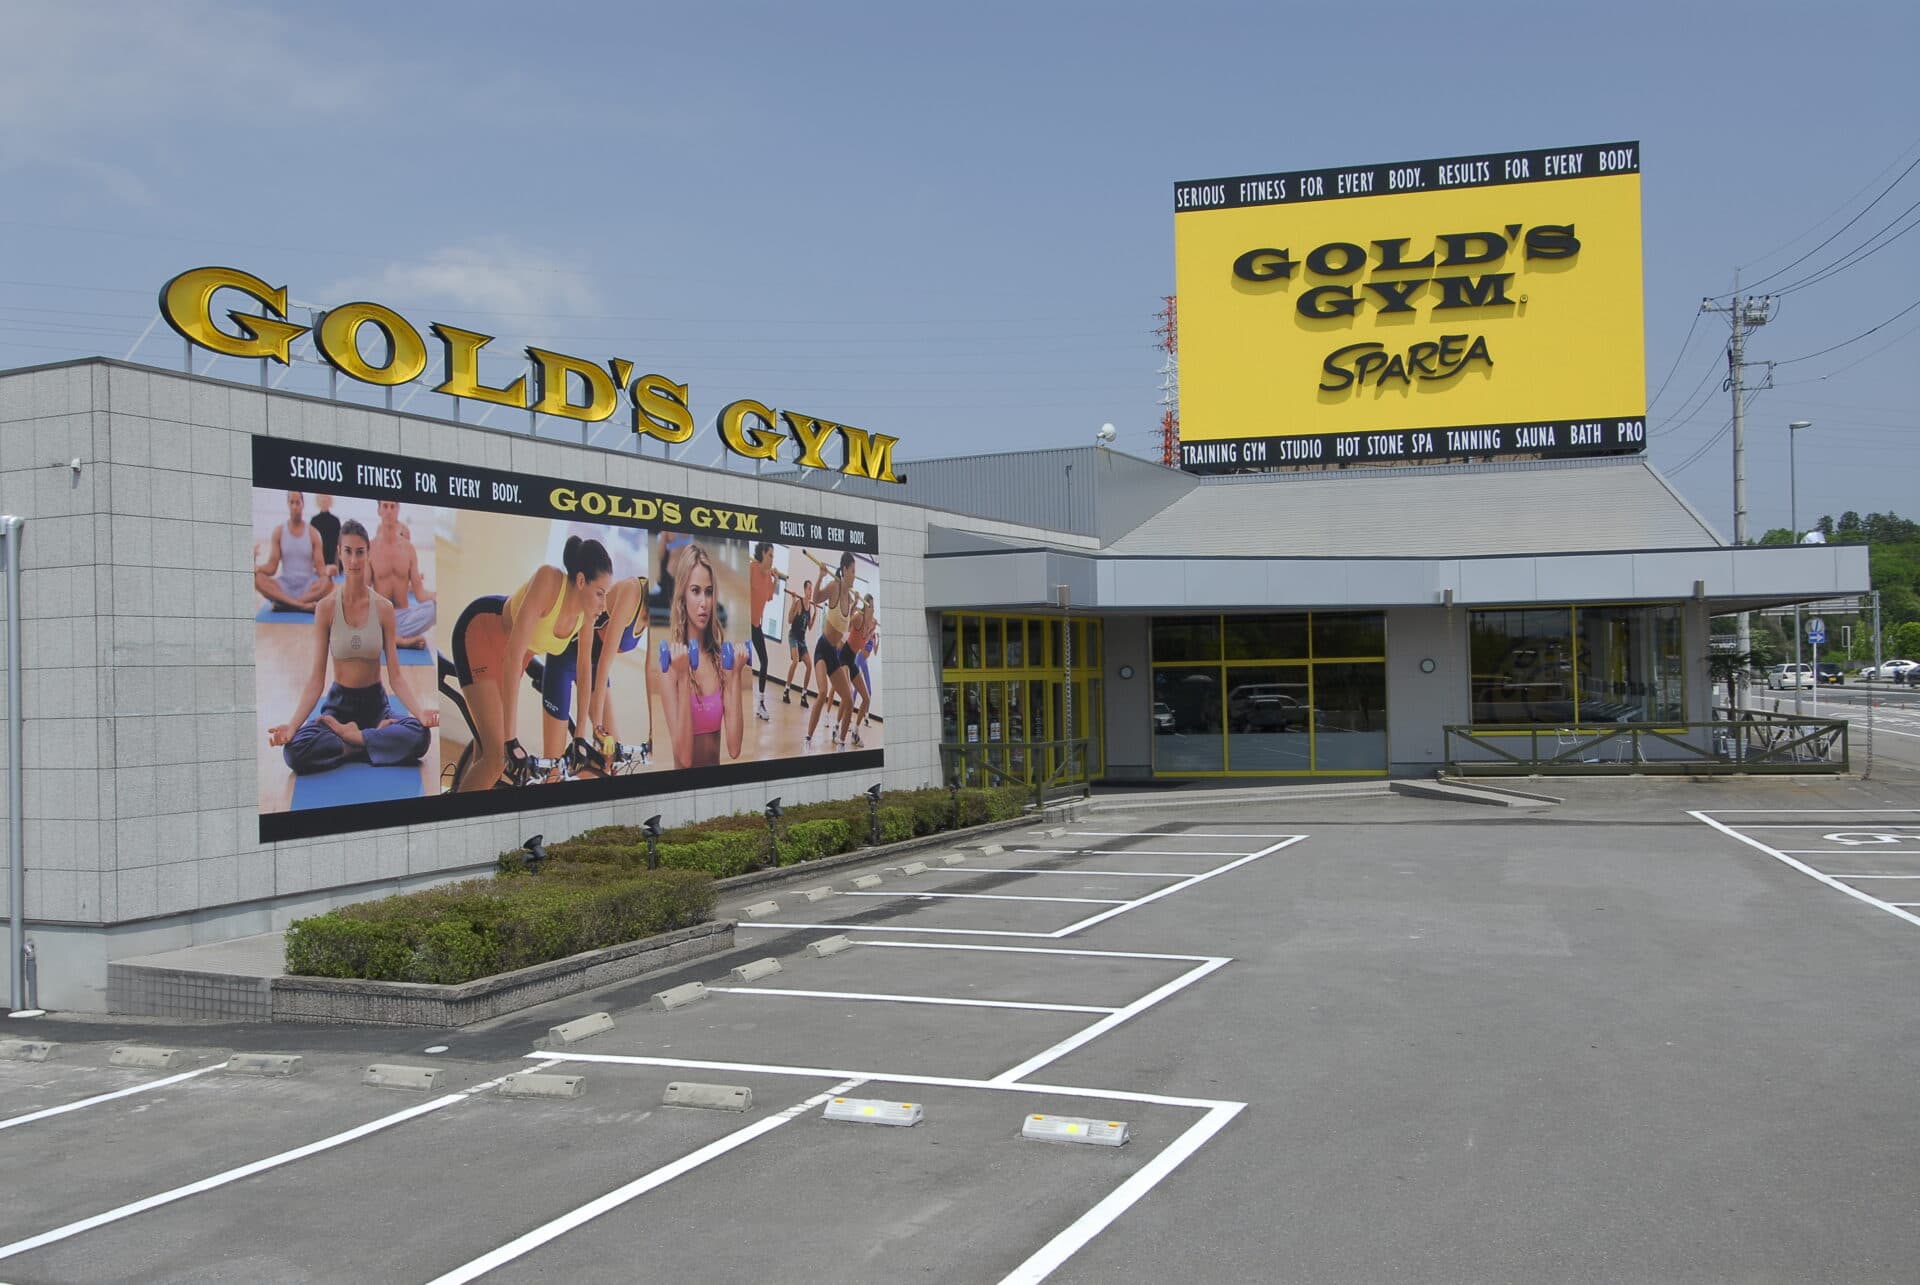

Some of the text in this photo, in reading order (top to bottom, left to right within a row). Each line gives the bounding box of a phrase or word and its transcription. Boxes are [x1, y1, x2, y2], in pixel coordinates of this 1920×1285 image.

[1177, 149, 1638, 208] SERIOUS FITNESS FOR EVERY BODY. RESULTS FOR EVERY BODY.
[1233, 223, 1581, 282] GOLD'S
[158, 265, 901, 484] GOLD'S GYM
[1319, 333, 1494, 392] SPAREA
[1182, 421, 1643, 465] TRAINING GYM STUDIO HOT STONE SPA TANNING SAUNA BATH PRO
[290, 455, 343, 483] SERIOUS
[357, 464, 402, 490] FITNESS
[415, 472, 437, 494] FOR
[449, 476, 481, 499] EVERY
[492, 482, 522, 504] BODY.
[550, 487, 682, 524] GOLD'S
[780, 520, 805, 538] RESULTS
[810, 524, 823, 540] FOR
[828, 526, 845, 543] EVERY
[849, 529, 867, 545] BODY.
